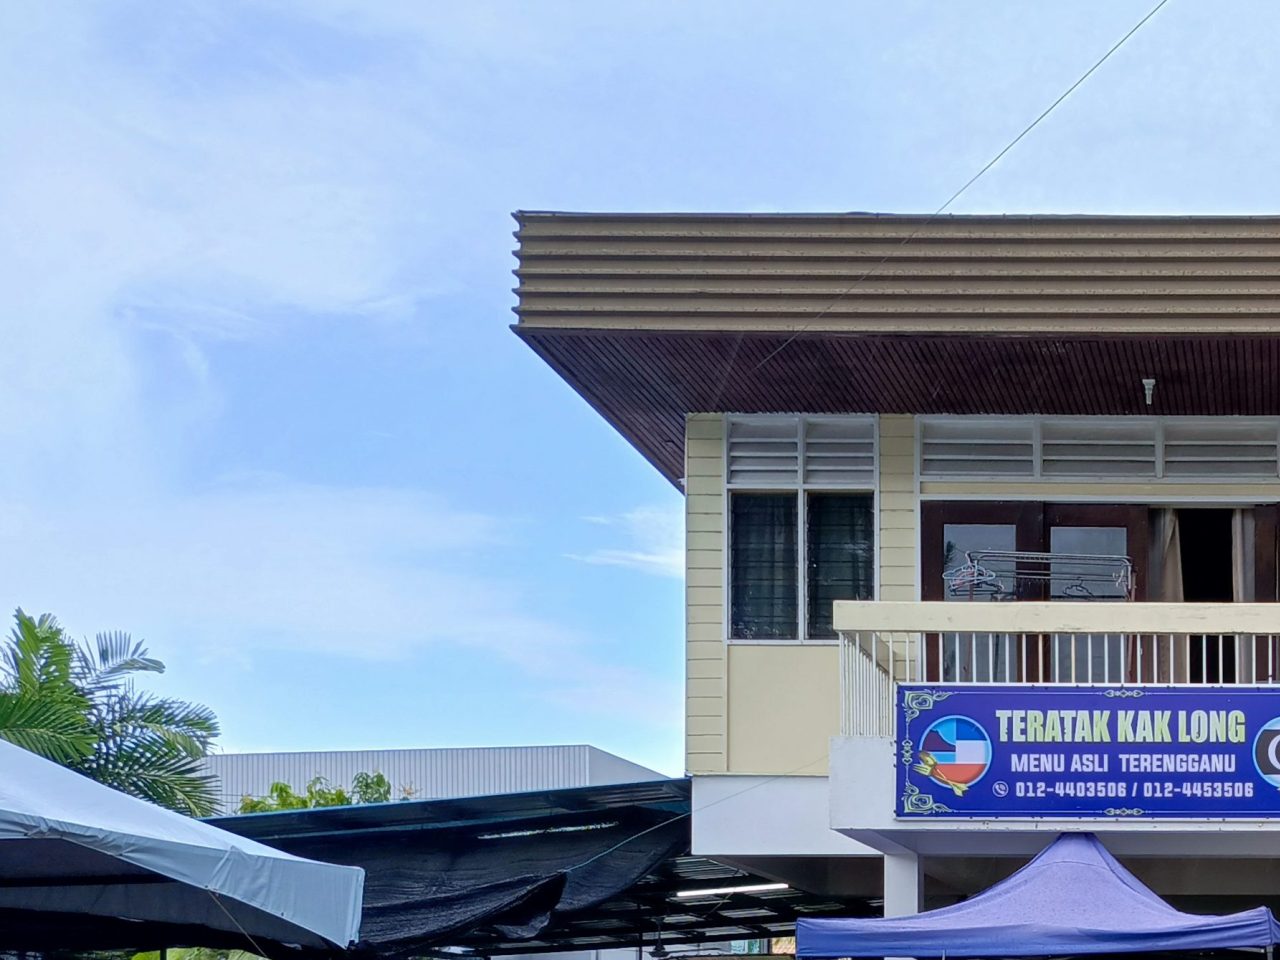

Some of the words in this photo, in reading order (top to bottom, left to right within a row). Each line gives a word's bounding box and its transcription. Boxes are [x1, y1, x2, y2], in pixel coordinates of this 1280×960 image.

[995, 710, 1111, 743] TERATAK
[1117, 710, 1172, 743] KAK
[1178, 709, 1246, 743] LONG
[1011, 753, 1065, 772] MENU
[1070, 753, 1108, 772] ASLI
[1118, 753, 1236, 773] TERENGGANU
[1015, 782, 1127, 797] 012-4403506
[1131, 782, 1138, 797] /
[1143, 782, 1254, 798] 012-4453506
